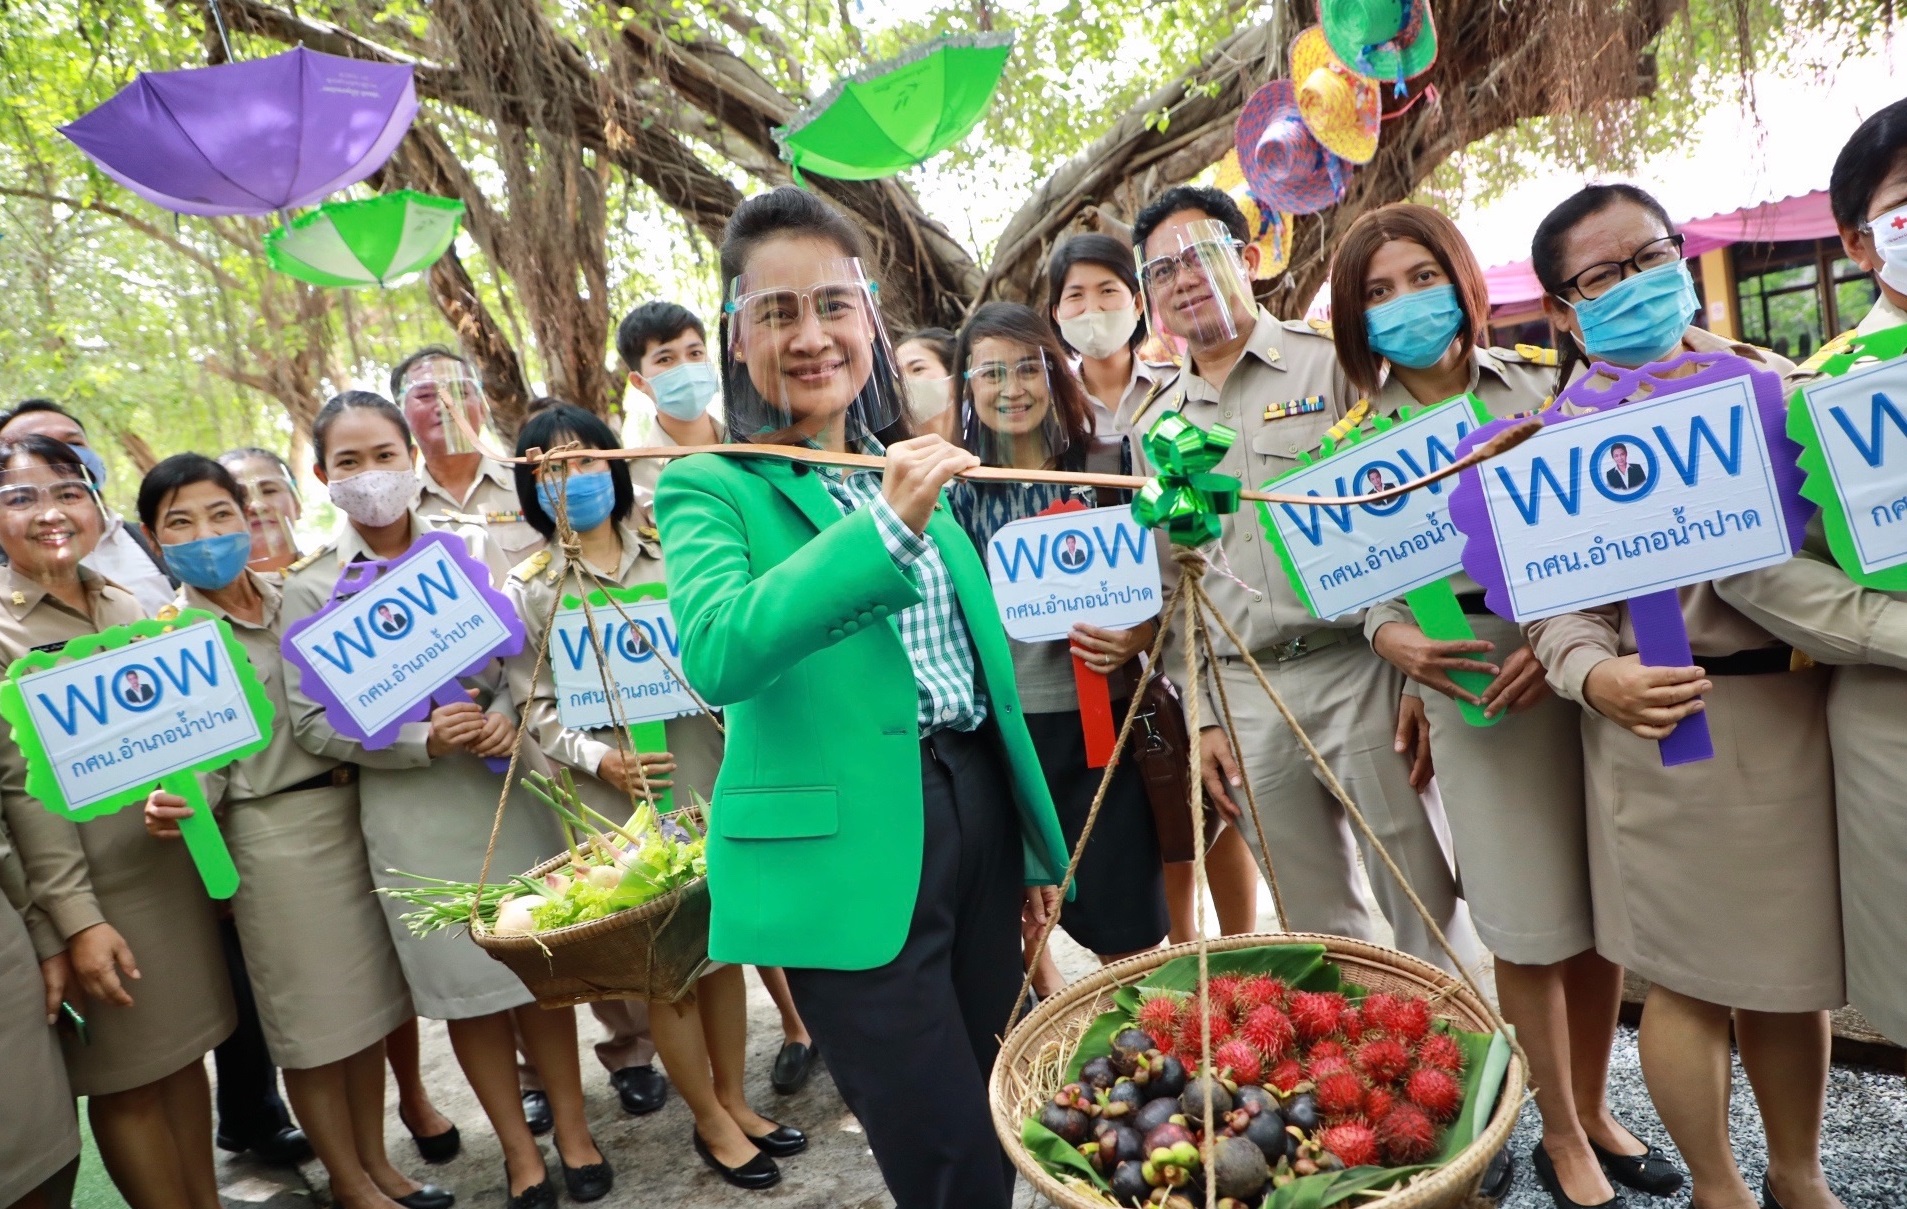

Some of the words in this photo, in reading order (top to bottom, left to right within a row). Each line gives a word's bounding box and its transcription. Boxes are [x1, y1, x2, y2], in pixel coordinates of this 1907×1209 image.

[1280, 420, 1468, 547] WOW
[1494, 405, 1744, 526] WOW
[993, 522, 1149, 584] WOW
[1319, 511, 1458, 591] กศน.อำเภอน้ำ
[1525, 505, 1761, 582] กศน.อำเภอน้ำปาด
[312, 559, 460, 675] WOW
[1006, 581, 1154, 620] กศน.อำเภอน้ำปาด
[37, 639, 219, 736] WOW
[358, 612, 485, 708] กศน.อำเภอน้ำปาด
[71, 706, 238, 777] กศน.อำเภอน้ำปาด
